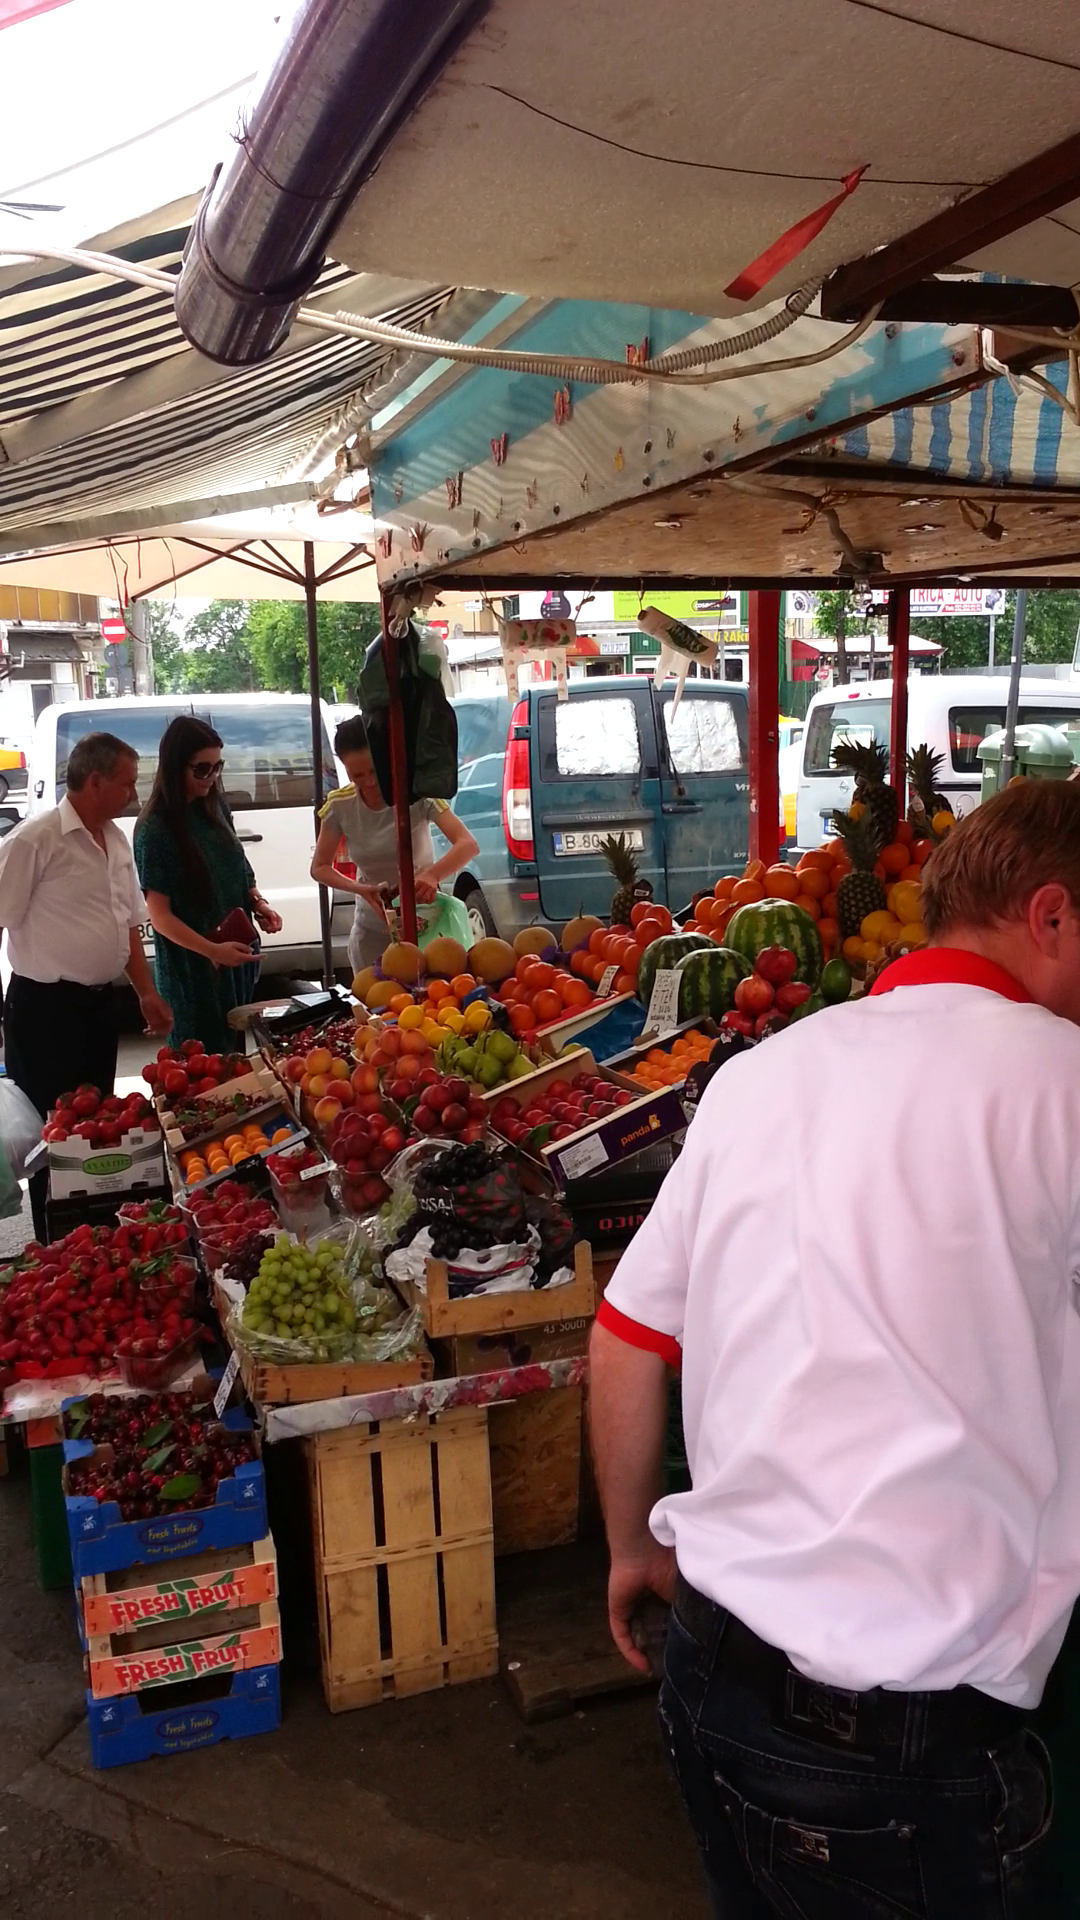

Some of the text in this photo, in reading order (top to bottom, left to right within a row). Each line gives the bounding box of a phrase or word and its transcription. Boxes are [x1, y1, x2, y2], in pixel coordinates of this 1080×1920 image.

[954, 588, 983, 602] AUTO
[620, 1126, 651, 1147] panda
[148, 1522, 198, 1541] Fresh Fruits
[109, 1580, 246, 1627] FRESH FRUIT
[115, 1642, 252, 1688] FRESH FRUIT
